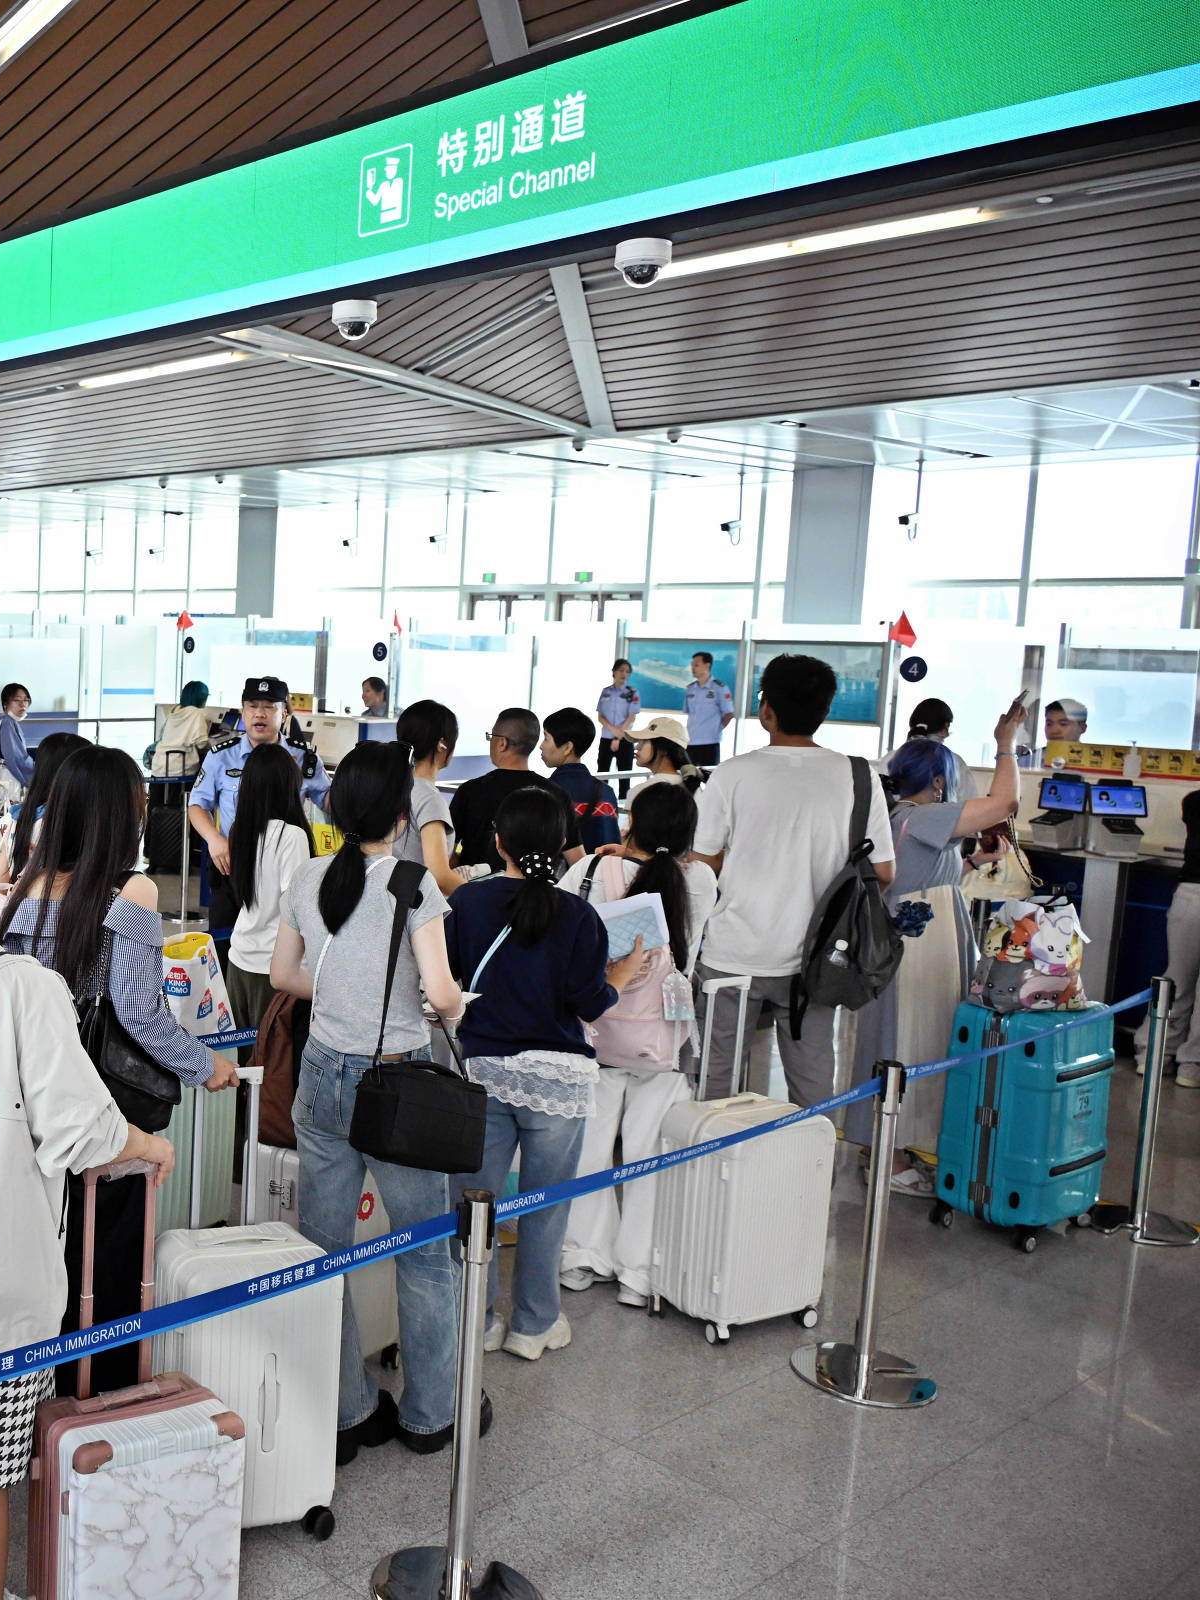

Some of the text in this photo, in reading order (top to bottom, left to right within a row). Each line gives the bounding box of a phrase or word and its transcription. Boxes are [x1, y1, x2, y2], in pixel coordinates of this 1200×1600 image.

[436, 90, 587, 178] 特别通道
[434, 152, 596, 221] Special Channel
[908, 662, 919, 676] 4
[167, 985, 189, 994] LOMO
[496, 1191, 546, 1215] IMMIGRATION
[247, 1231, 412, 1296] 中国移民管理 CHINA IMMIGRATION
[24, 1344, 63, 1364] CHINA
[65, 1318, 142, 1352] IMMIGRATION
